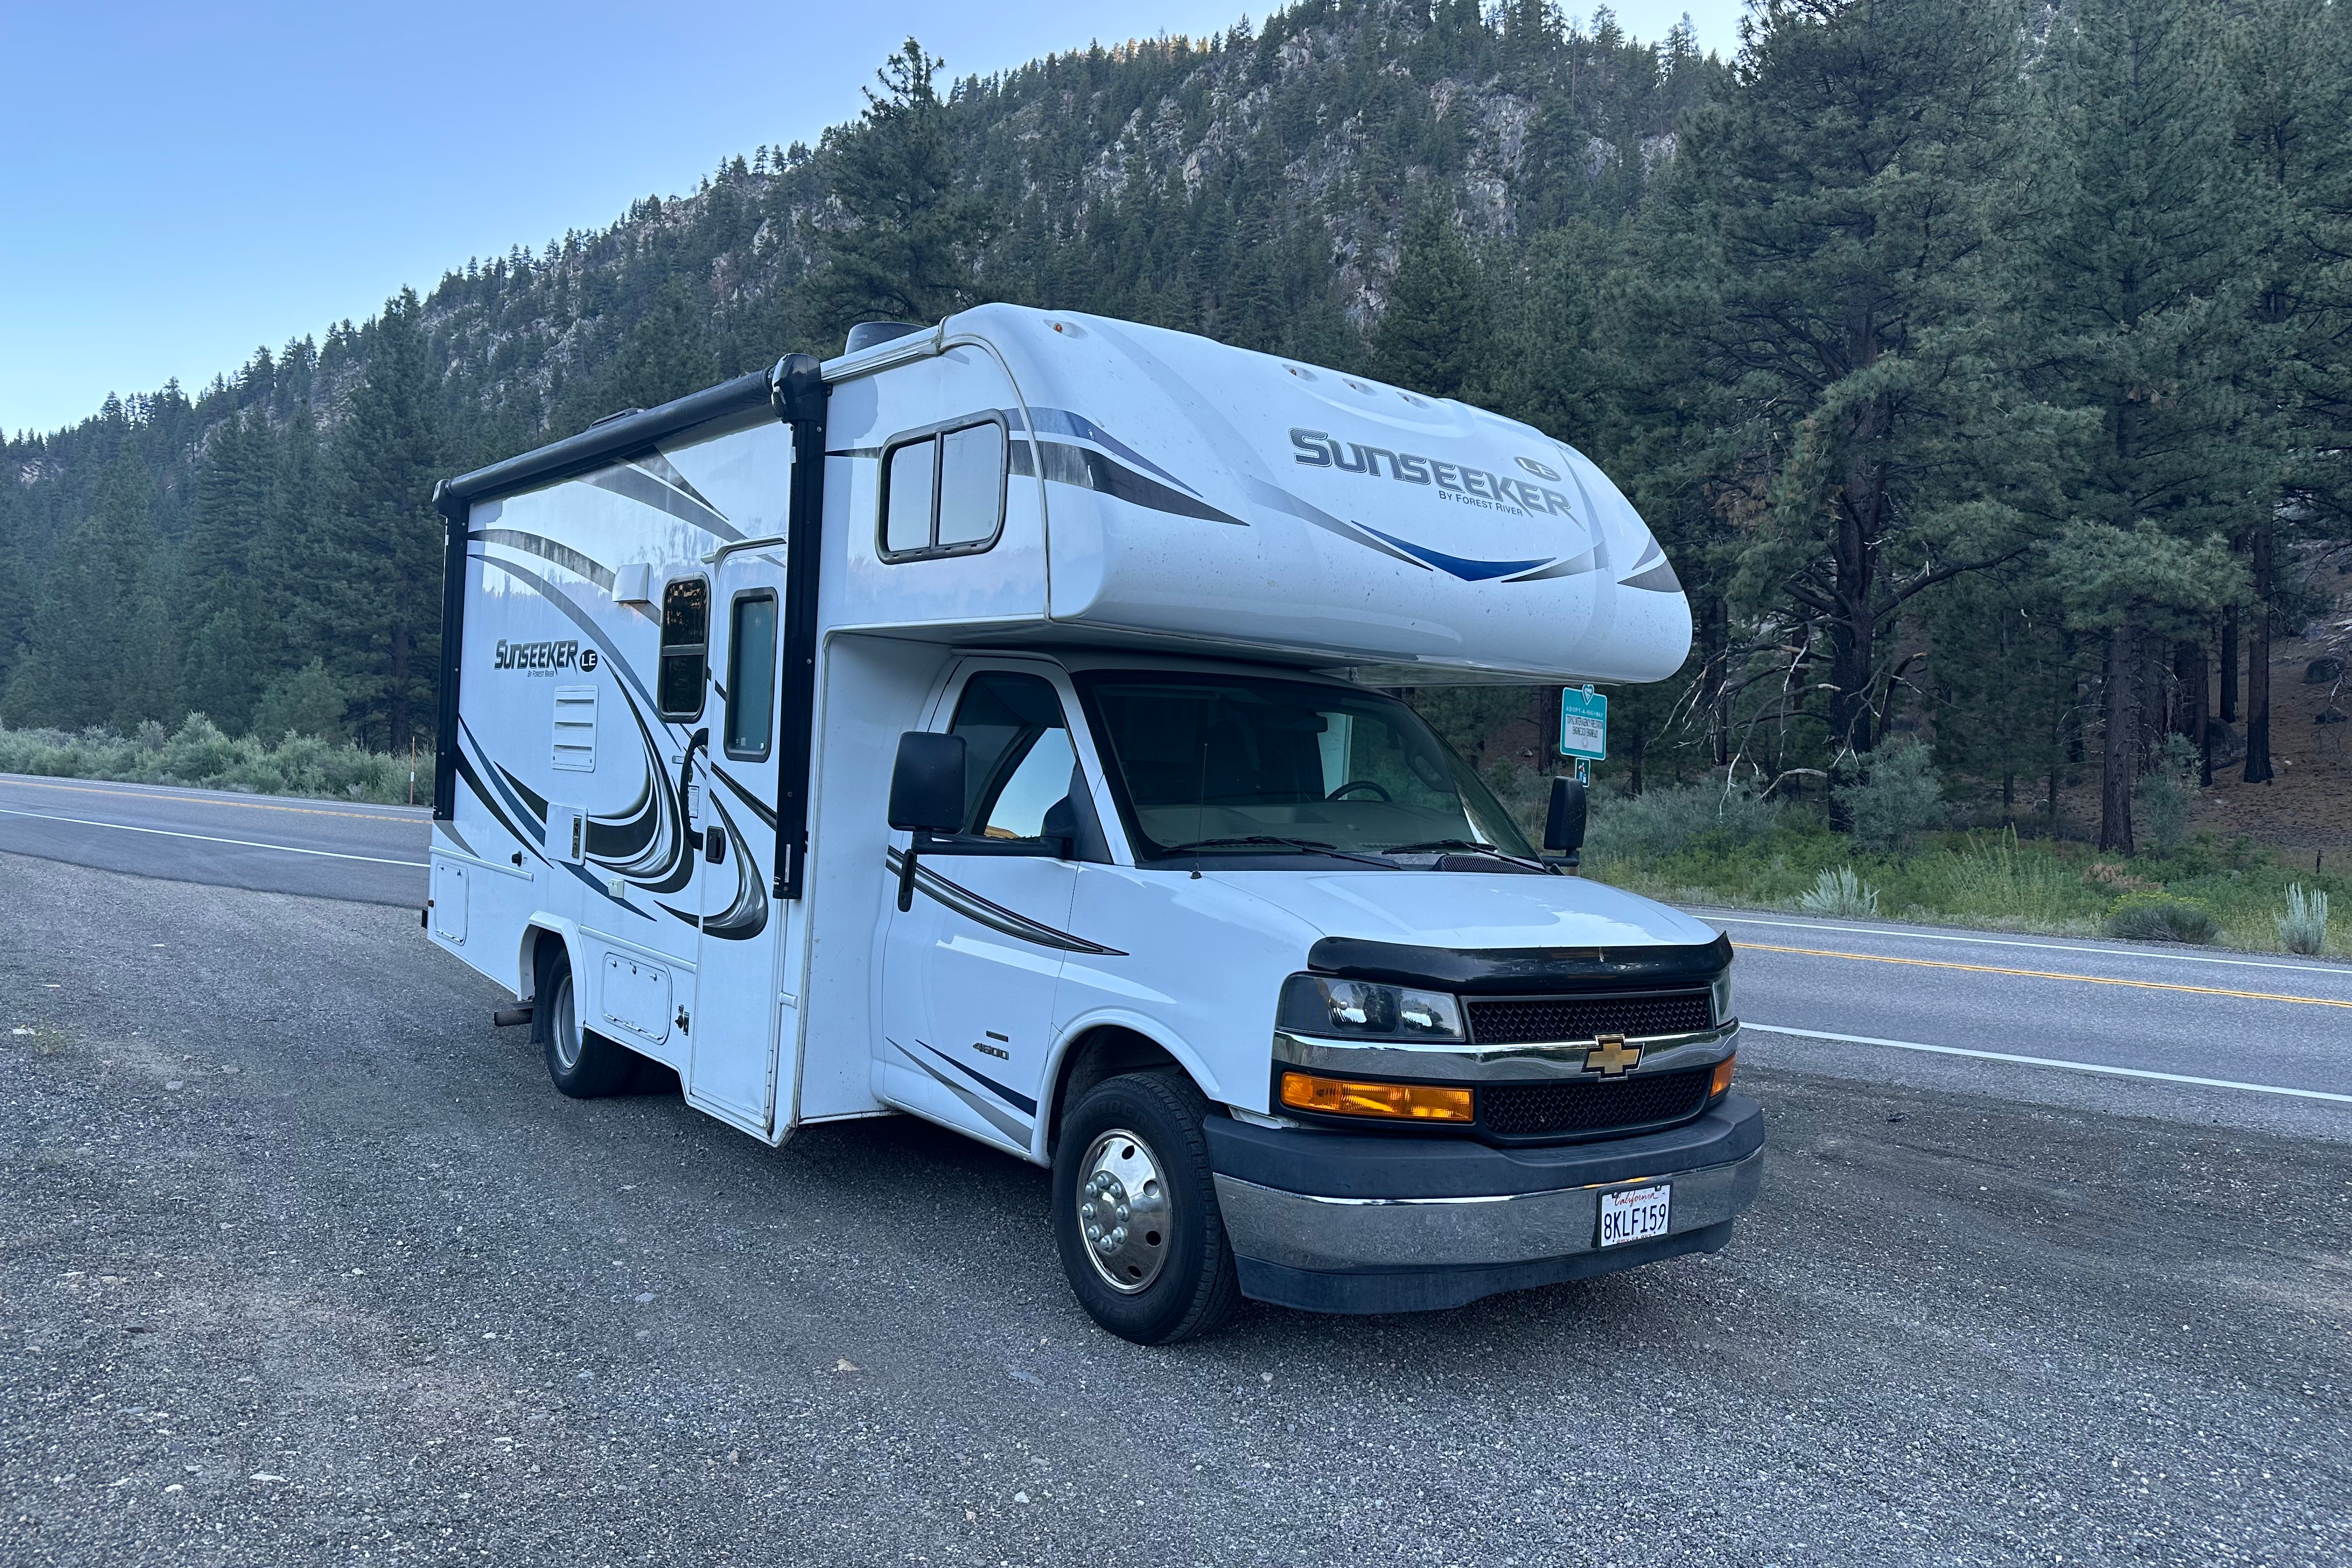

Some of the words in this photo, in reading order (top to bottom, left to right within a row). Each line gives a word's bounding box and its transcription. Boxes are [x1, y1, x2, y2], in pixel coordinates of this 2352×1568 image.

[1438, 490, 1452, 501] BY
[1455, 494, 1493, 509] FOREST
[1495, 502, 1523, 517] RIVER
[581, 653, 596, 666] LE
[1615, 1191, 1658, 1208] California
[1604, 1203, 1666, 1240] 8KLF159
